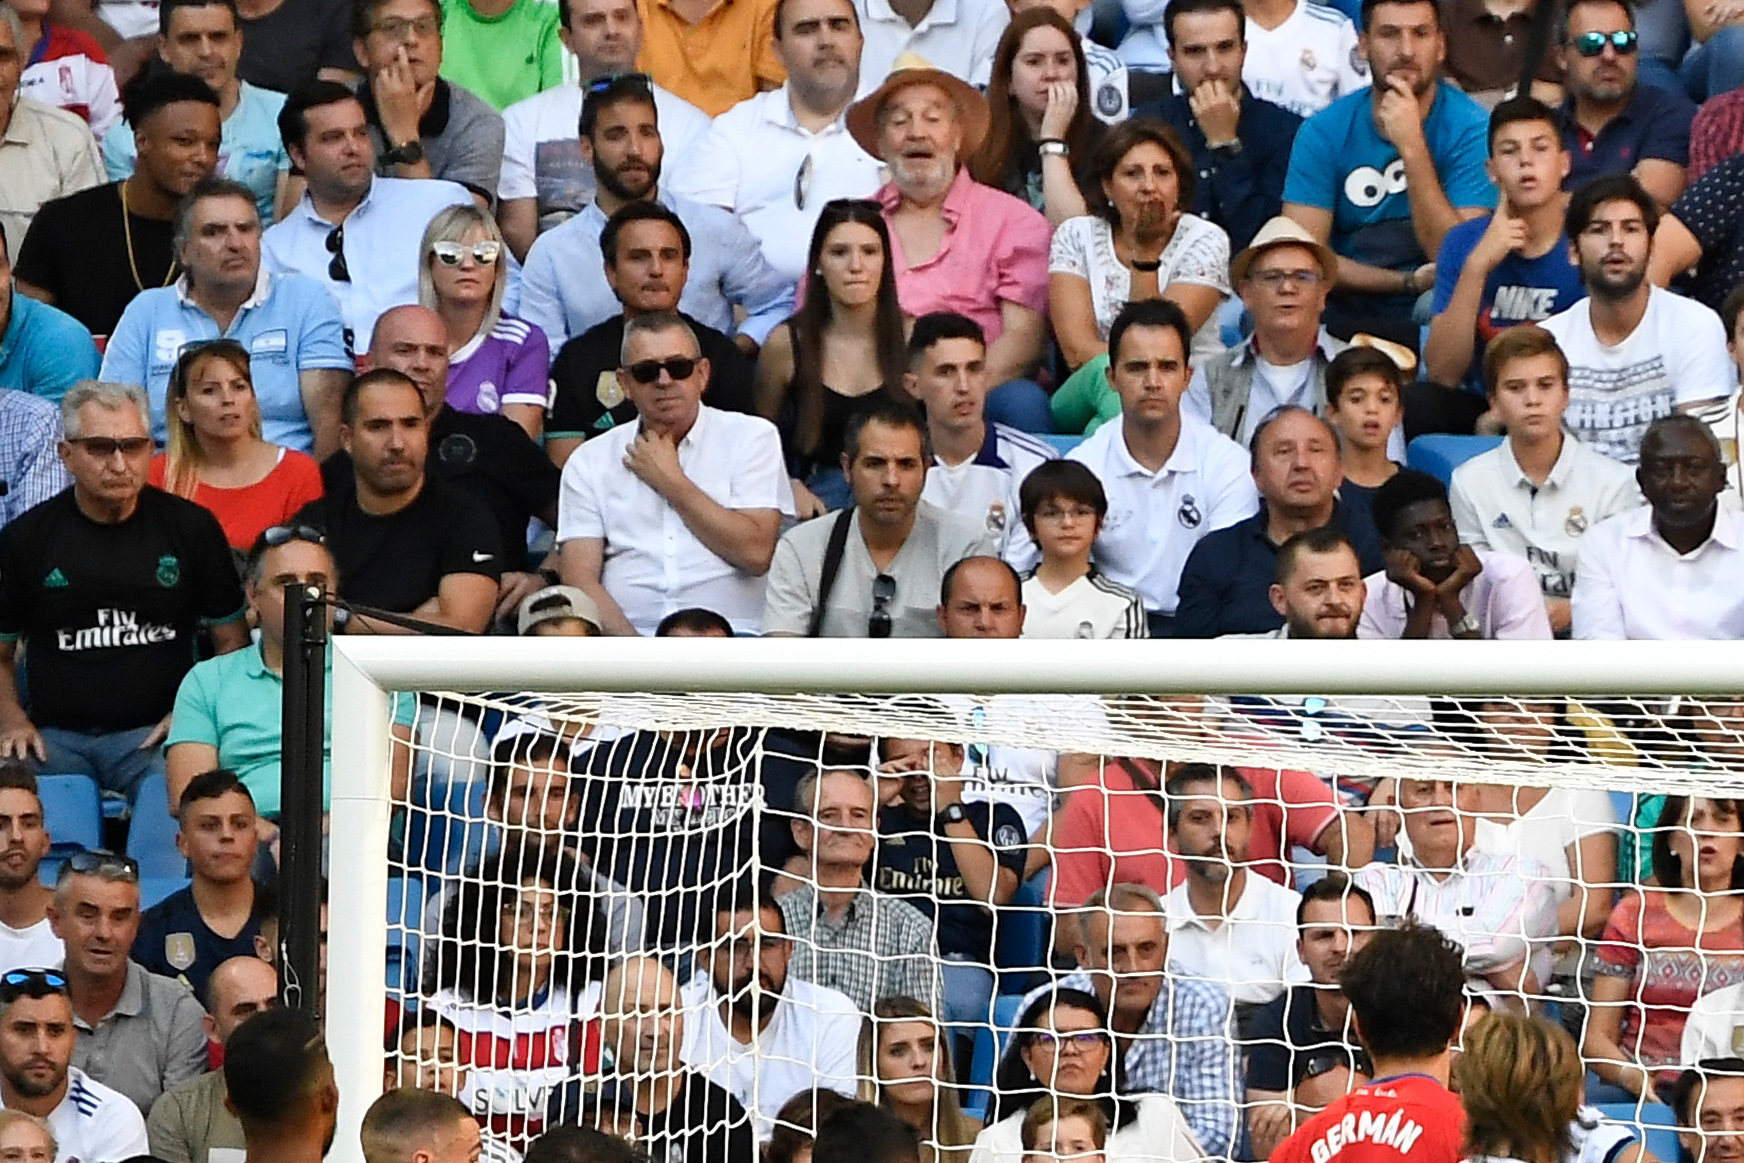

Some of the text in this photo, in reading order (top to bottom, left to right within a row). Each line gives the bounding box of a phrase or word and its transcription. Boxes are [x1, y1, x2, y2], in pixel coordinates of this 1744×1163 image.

[1489, 284, 1560, 321] NIKE
[97, 608, 136, 627] Fly
[57, 623, 177, 651] Emirates
